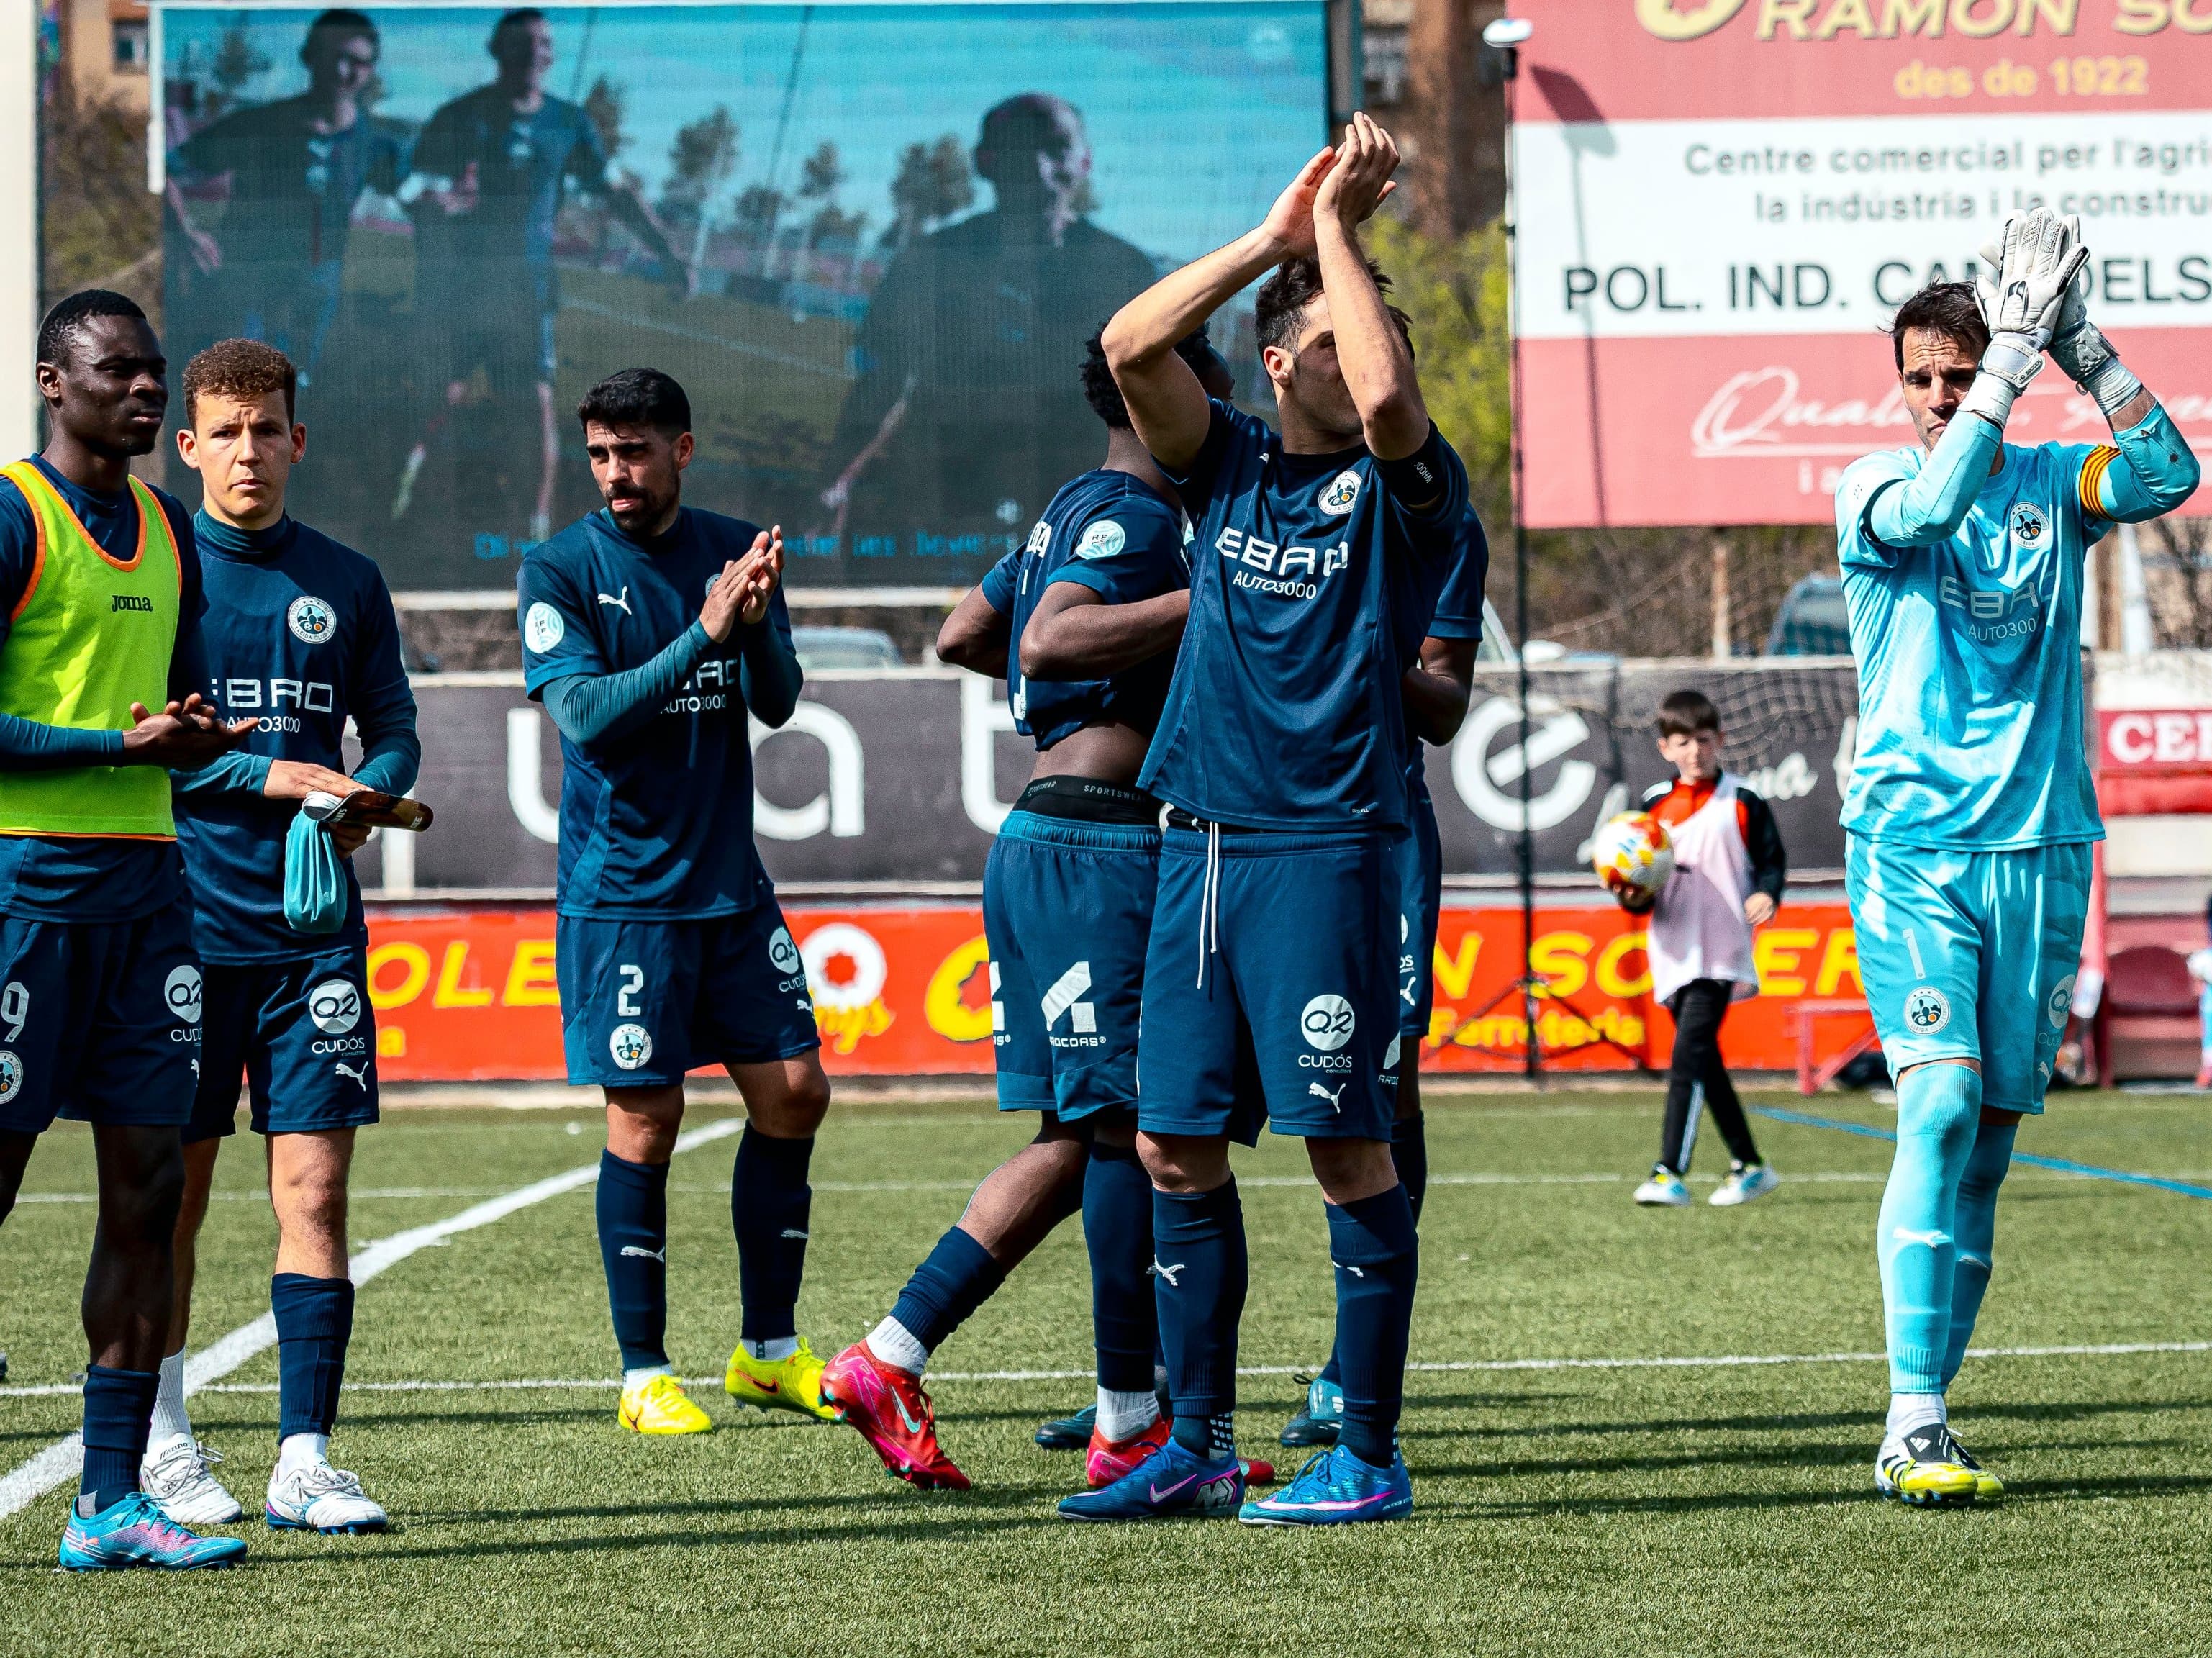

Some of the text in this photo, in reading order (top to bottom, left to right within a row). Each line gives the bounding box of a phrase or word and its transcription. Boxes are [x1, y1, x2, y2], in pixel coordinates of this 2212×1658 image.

[1894, 54, 2151, 99] des de 1922
[1684, 143, 1815, 175] Centre
[1829, 138, 2023, 173] comercial
[2037, 143, 2099, 176] per
[1755, 192, 1788, 222] la
[1564, 265, 1703, 312] POL.
[1728, 263, 1846, 308] IND.
[1233, 569, 1317, 601] AUTO3000
[1968, 615, 2039, 642] AUTO300
[212, 678, 333, 713] BRO
[1084, 784, 1147, 802] SPORTSWEA
[1902, 928, 1926, 980] 1
[366, 941, 561, 1010] OLE
[617, 964, 644, 1017] 2
[313, 992, 359, 1018] Q2
[1304, 1009, 1354, 1035] Q2
[311, 1036, 366, 1054] CUDÓS
[1297, 1054, 1353, 1068] CUDÓS
